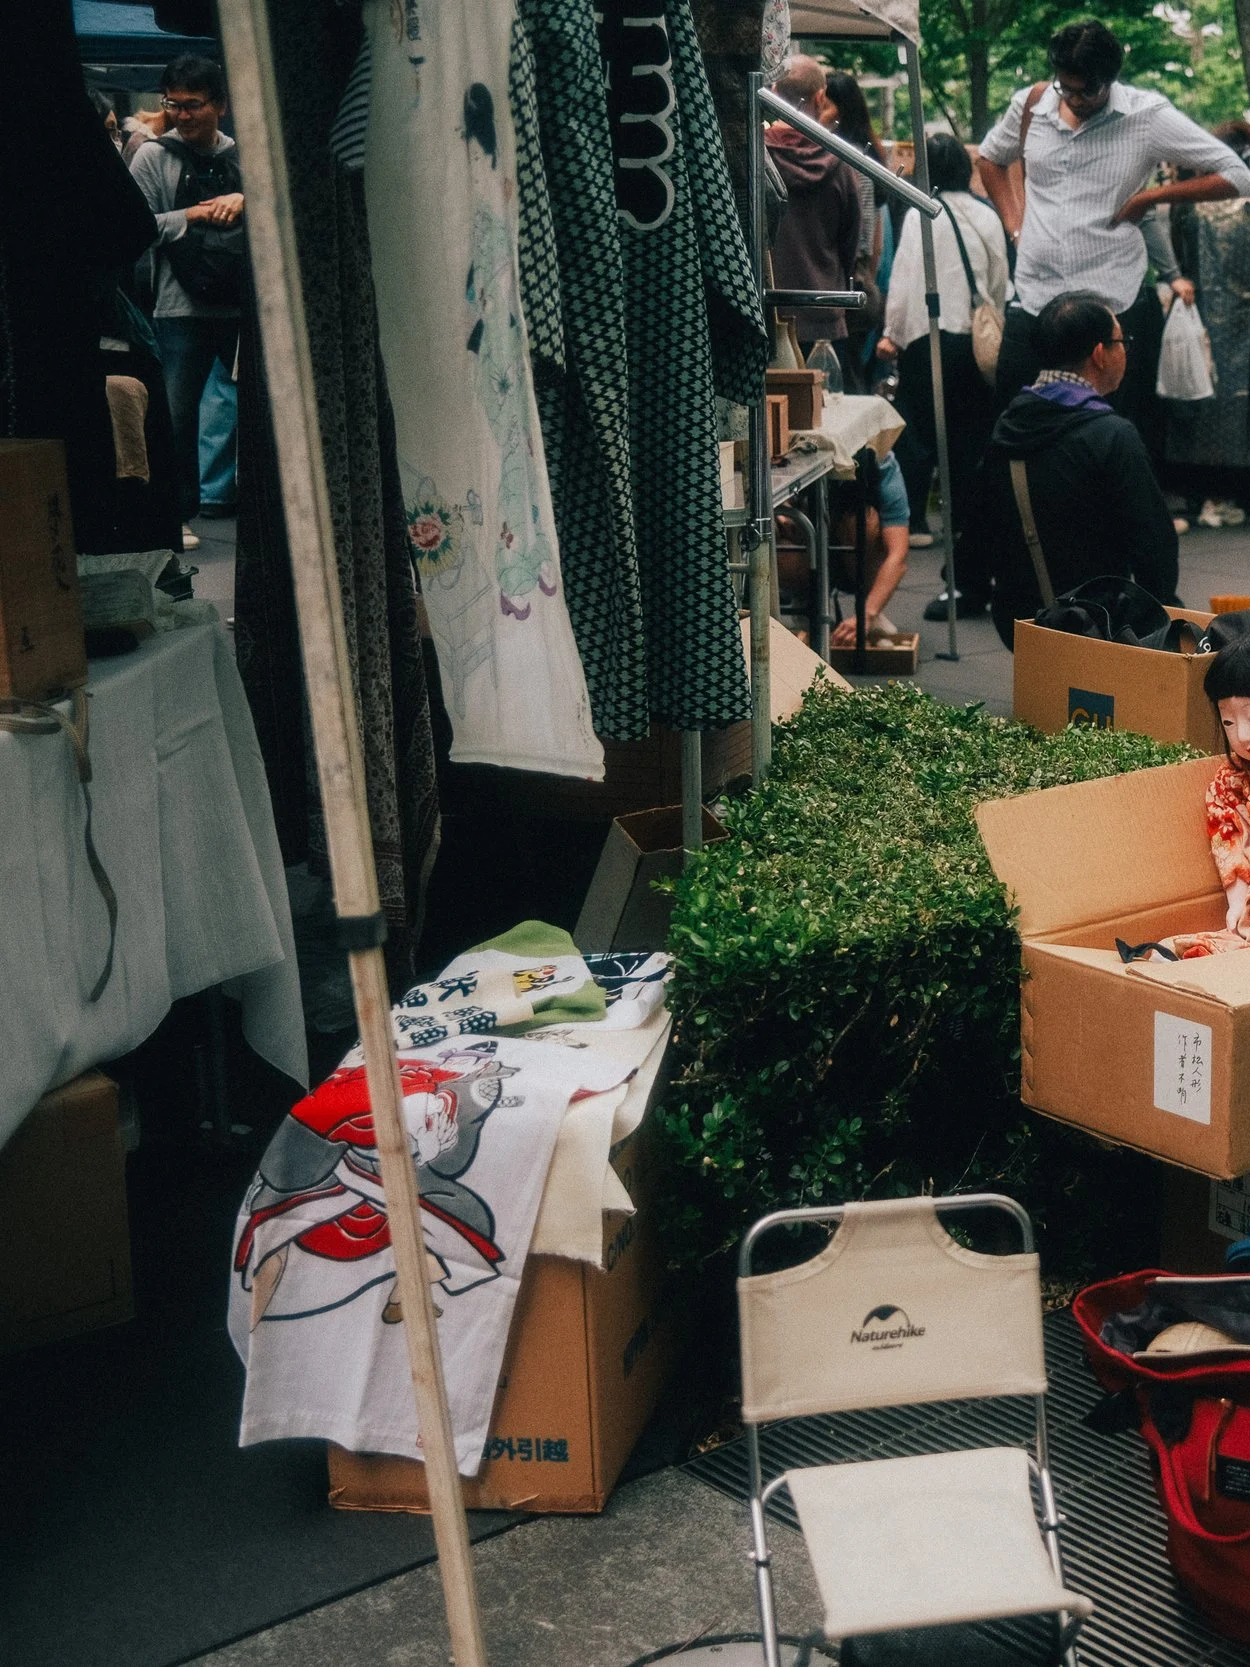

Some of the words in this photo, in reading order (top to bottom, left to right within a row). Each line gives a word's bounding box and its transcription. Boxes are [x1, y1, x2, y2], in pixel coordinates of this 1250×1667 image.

[1190, 1031, 1204, 1093] 市松人形
[850, 1324, 926, 1344] Naturehike
